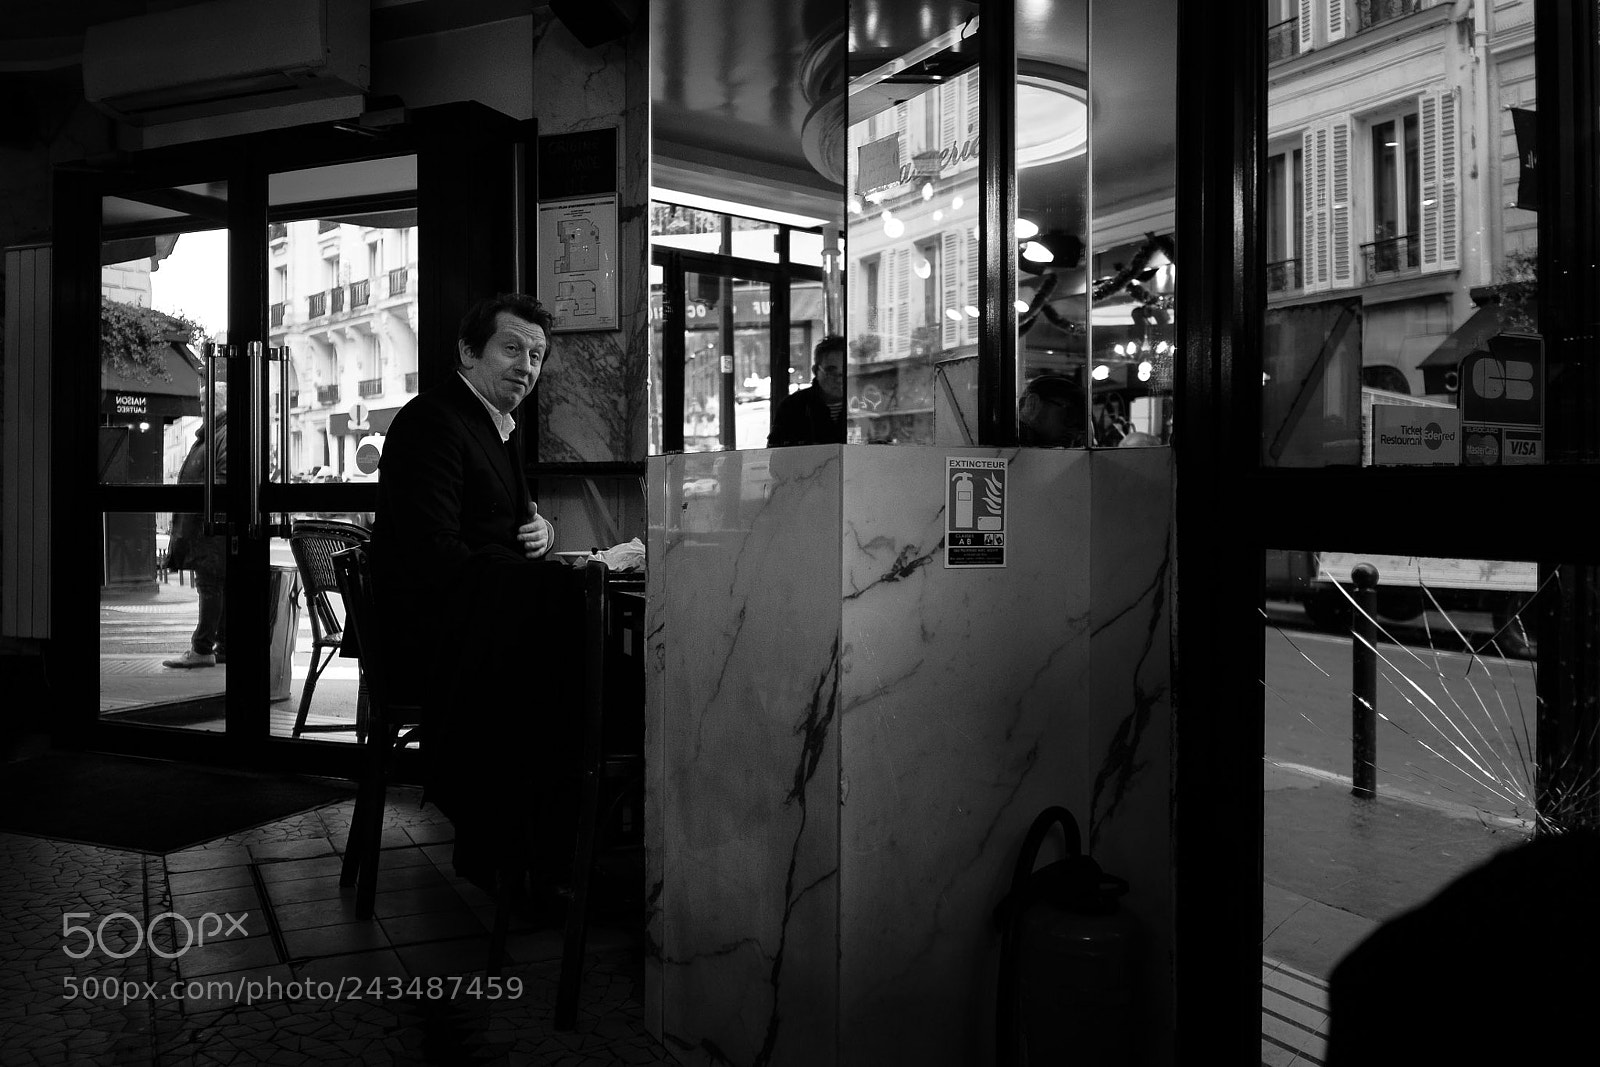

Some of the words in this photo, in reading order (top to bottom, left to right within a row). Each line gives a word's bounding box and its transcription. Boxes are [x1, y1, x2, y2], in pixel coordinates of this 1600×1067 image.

[1401, 425, 1423, 436] Ticket
[1423, 430, 1456, 441] Edenred
[1380, 434, 1423, 446] Restaurant
[1511, 441, 1536, 455] VISA
[949, 460, 1005, 468] EXTINCTEUR
